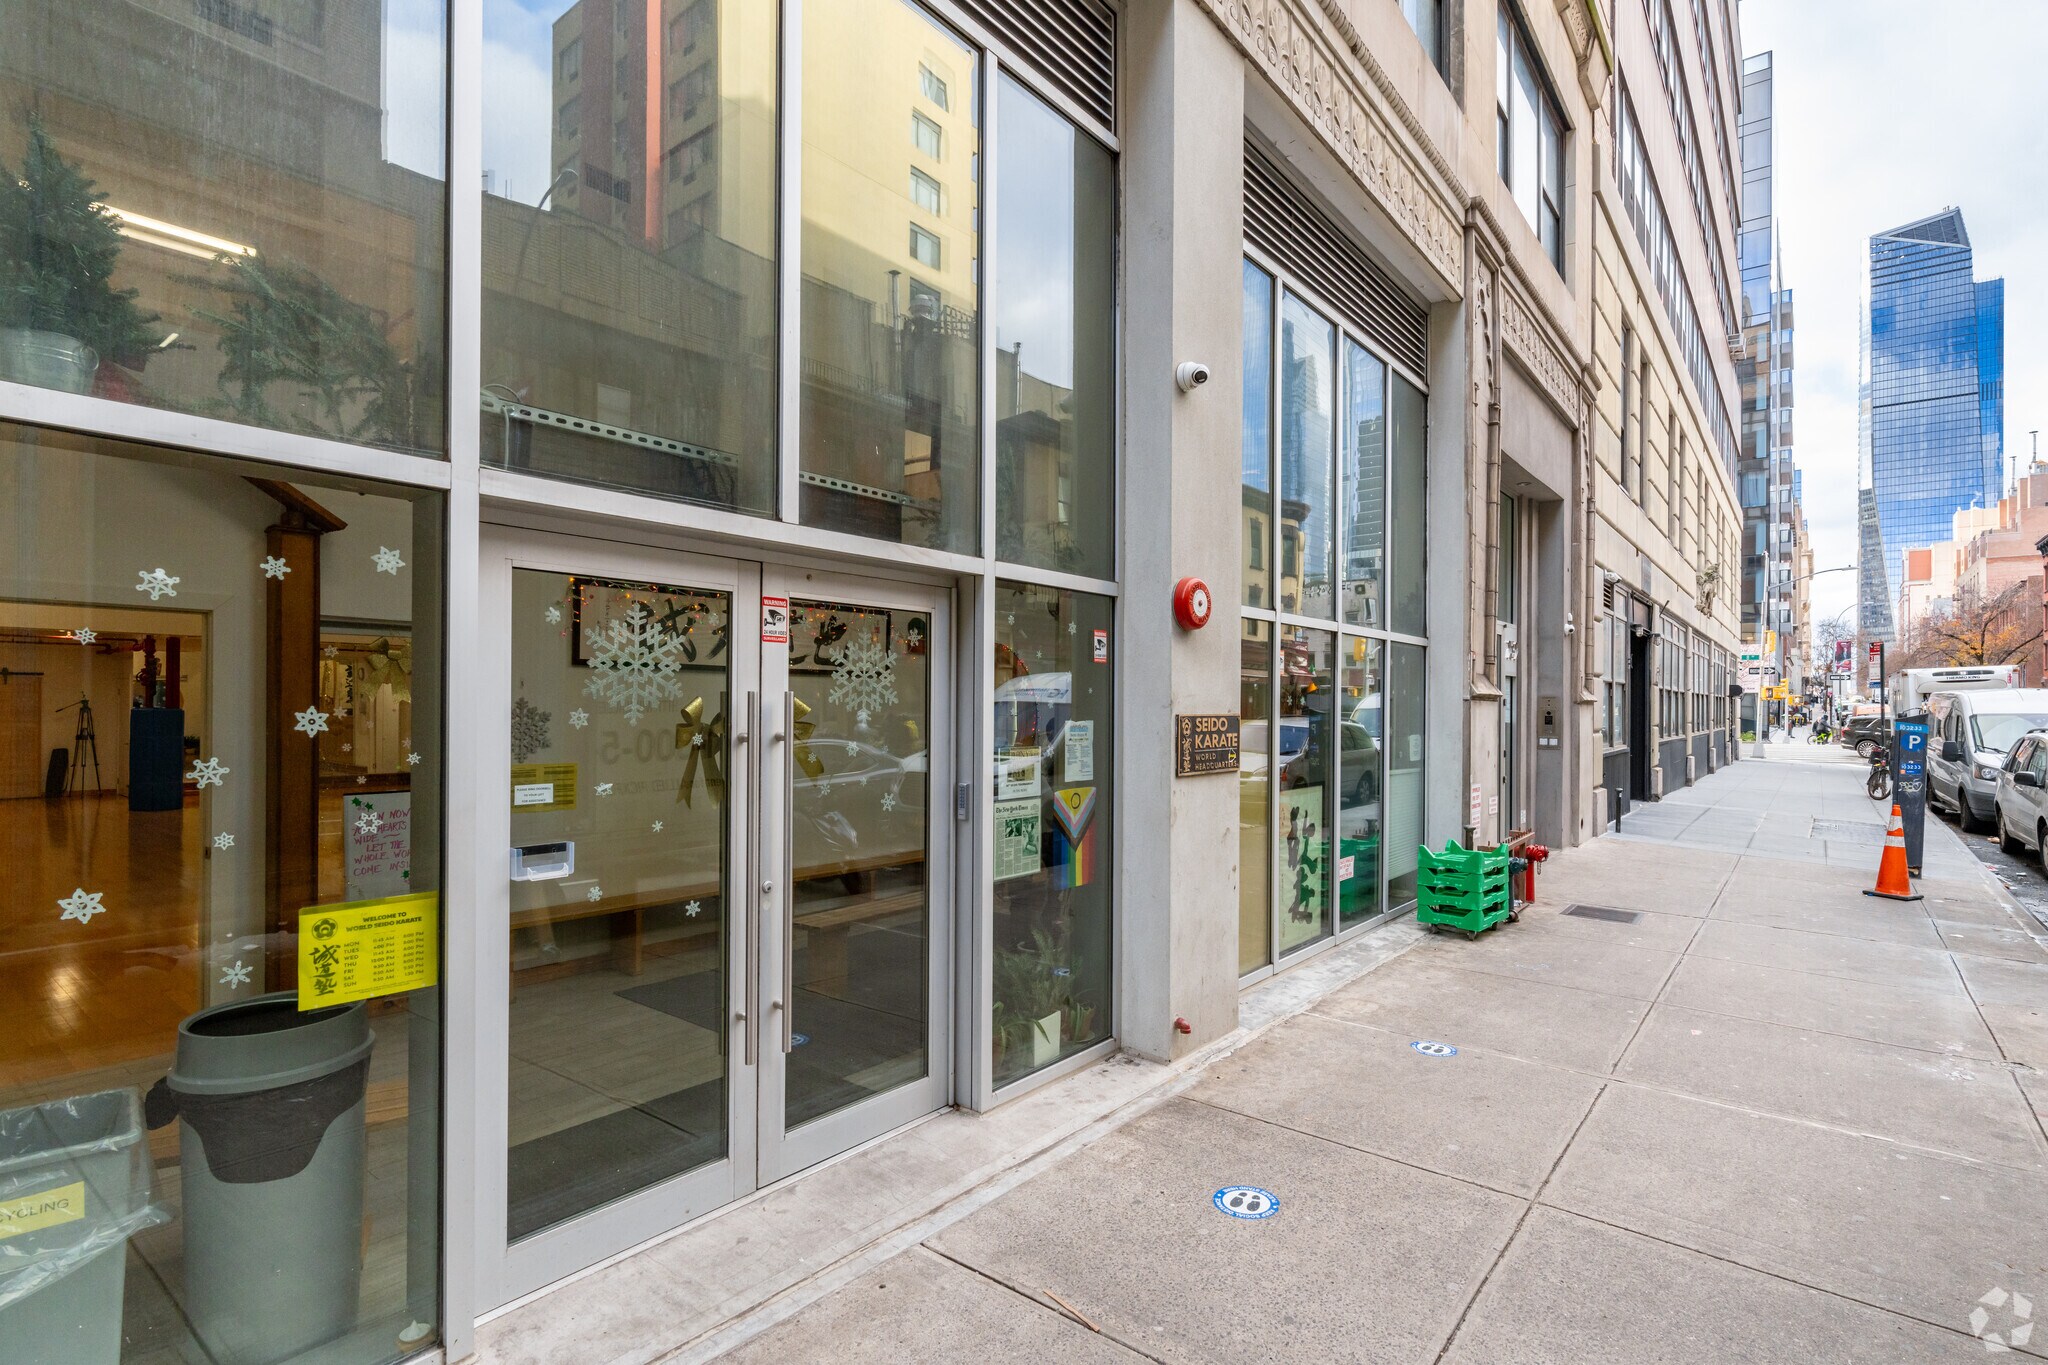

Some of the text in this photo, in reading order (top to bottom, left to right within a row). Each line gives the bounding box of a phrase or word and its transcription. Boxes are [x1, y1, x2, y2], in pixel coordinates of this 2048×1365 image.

[764, 599, 786, 607] WARNING
[1195, 717, 1228, 732] SEIDO
[1195, 732, 1238, 749] KARATE
[1908, 735, 1921, 750] P
[1195, 753, 1217, 761] WORLD
[1194, 760, 1237, 770] HEADQUARTERS
[389, 808, 411, 819] NOW
[377, 821, 407, 833] HEARTS
[354, 834, 378, 845] WIDE
[366, 843, 386, 852] LET
[354, 852, 387, 864] WHOLE
[353, 865, 381, 877] COME
[363, 913, 396, 922] WELCOME
[346, 916, 422, 932] WORLD SEIDO KARATE
[0, 1199, 69, 1222] YCLING
